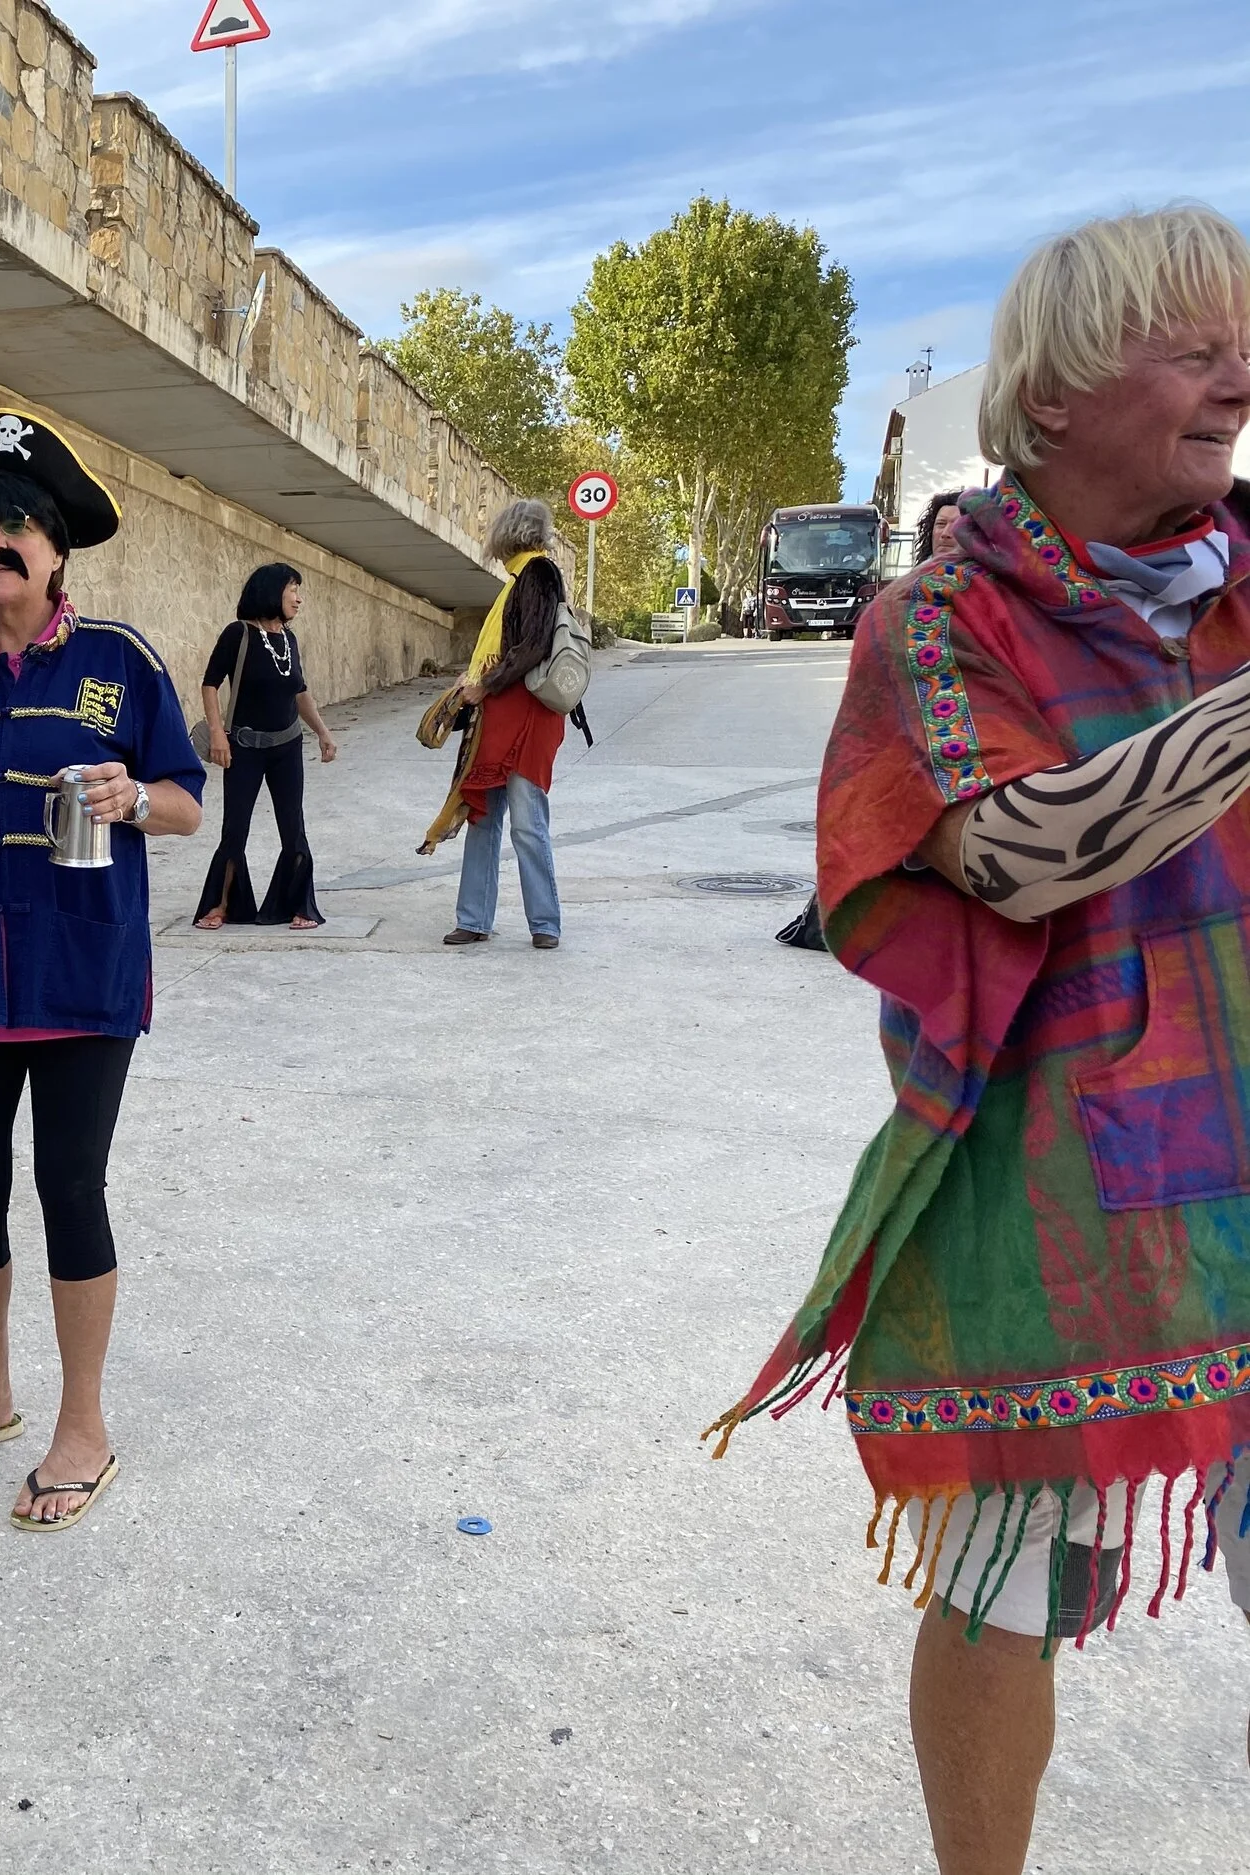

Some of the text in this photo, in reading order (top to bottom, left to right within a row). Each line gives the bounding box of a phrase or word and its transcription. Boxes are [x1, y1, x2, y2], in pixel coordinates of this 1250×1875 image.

[580, 487, 606, 503] 30
[83, 679, 120, 697] Bangkok
[83, 688, 104, 703] Hash
[82, 697, 106, 713] House
